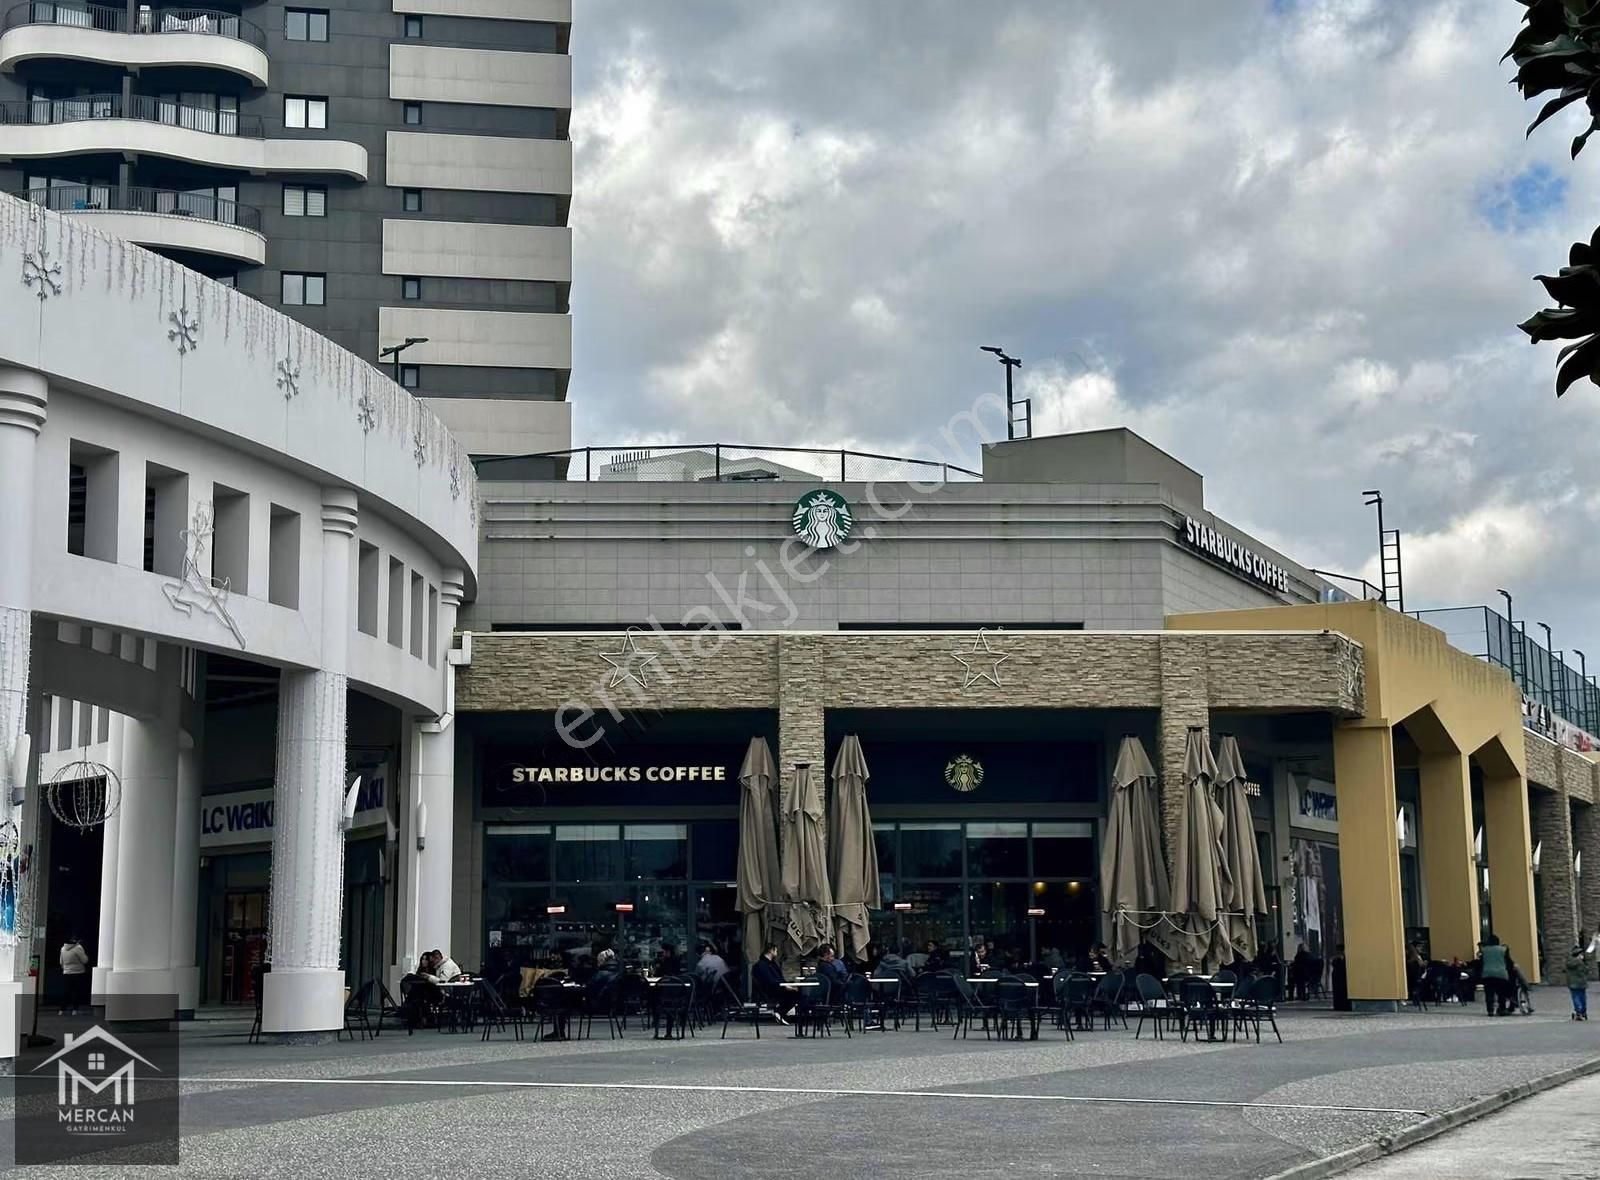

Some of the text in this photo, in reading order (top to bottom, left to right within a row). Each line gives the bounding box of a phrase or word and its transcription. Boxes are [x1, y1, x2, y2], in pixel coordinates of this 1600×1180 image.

[1186, 515, 1289, 593] STARBUCKS COFFEE
[512, 766, 726, 783] STARBUCKS COFFEE
[202, 806, 224, 834] LC
